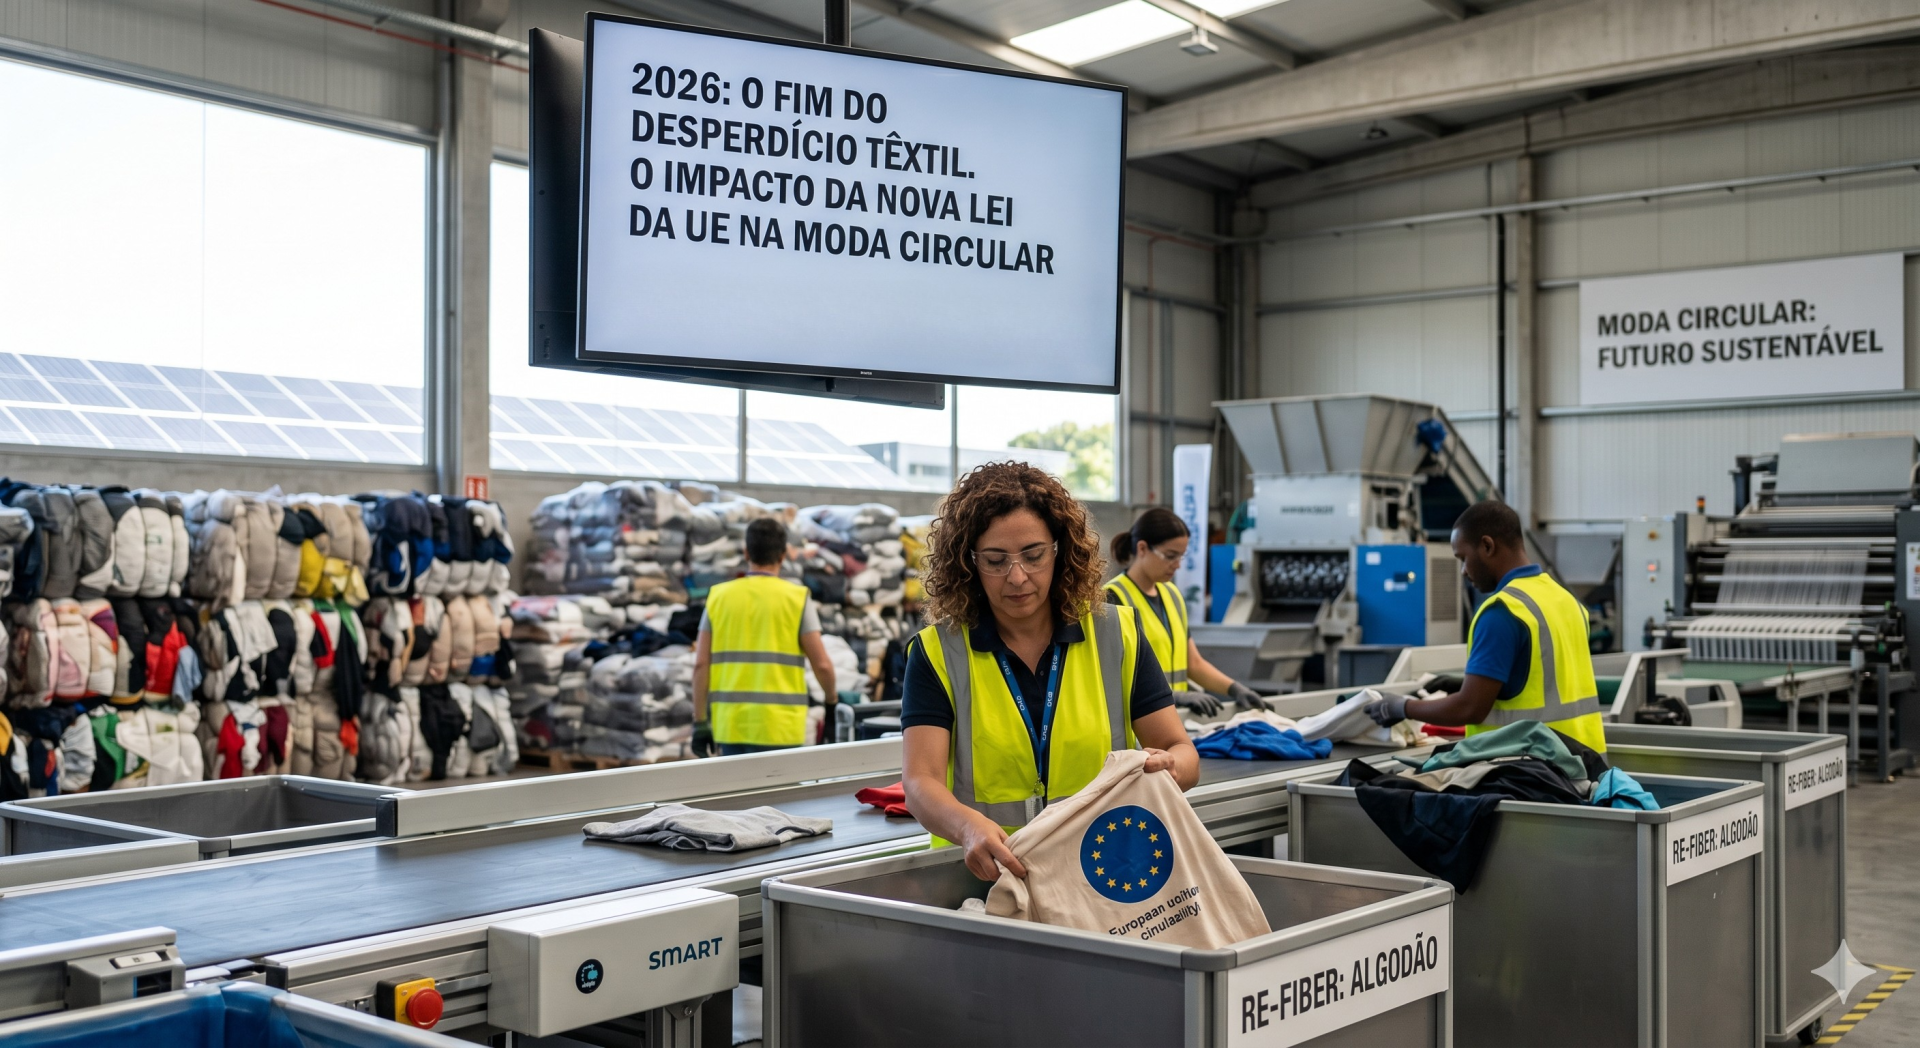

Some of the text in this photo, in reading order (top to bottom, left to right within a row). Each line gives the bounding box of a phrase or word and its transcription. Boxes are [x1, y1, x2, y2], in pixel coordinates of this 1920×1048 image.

[632, 63, 887, 123] 2026: O FIM DO
[632, 110, 975, 178] DESPERDÍCIO TÊXTIL.
[631, 158, 1013, 226] O IMPACTO DA NOVA LEI
[630, 204, 1054, 274] DA UE NA MODA CIRCULAR
[1598, 299, 1816, 336] MODA CIRCULAR:
[1598, 325, 1884, 369] FUTURO SUSTENTÁVEL
[1788, 757, 1843, 795] RE-FIBER: ALGODÃO
[1673, 811, 1758, 865] RE-FIBER: ALGODÃO
[648, 937, 723, 970] SMART
[1242, 931, 1438, 1034] RE-FIBER: ALGODÃO
